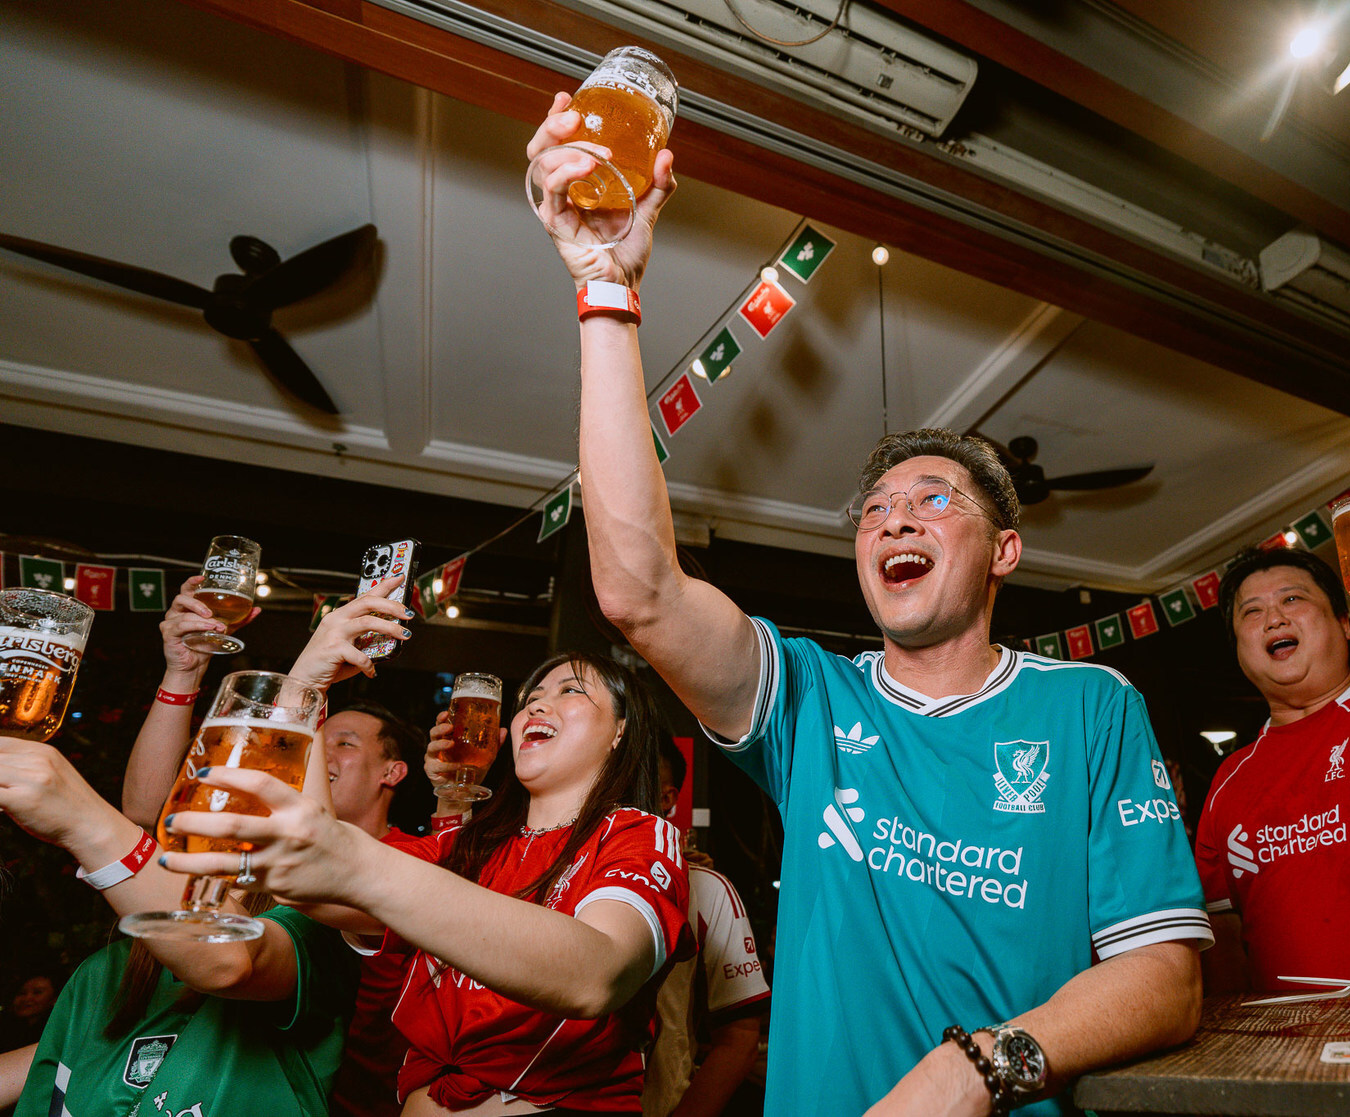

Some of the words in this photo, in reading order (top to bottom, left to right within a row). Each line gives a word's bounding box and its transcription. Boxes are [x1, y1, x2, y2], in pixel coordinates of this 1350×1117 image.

[995, 802, 1026, 812] FOOTBALL
[1028, 803, 1044, 812] CLUB
[1118, 799, 1181, 827] Expe
[1256, 804, 1340, 844] standard
[872, 816, 1024, 876] standard
[1258, 823, 1347, 863] chartered
[868, 845, 1029, 910] chartered
[723, 960, 761, 980] Expe
